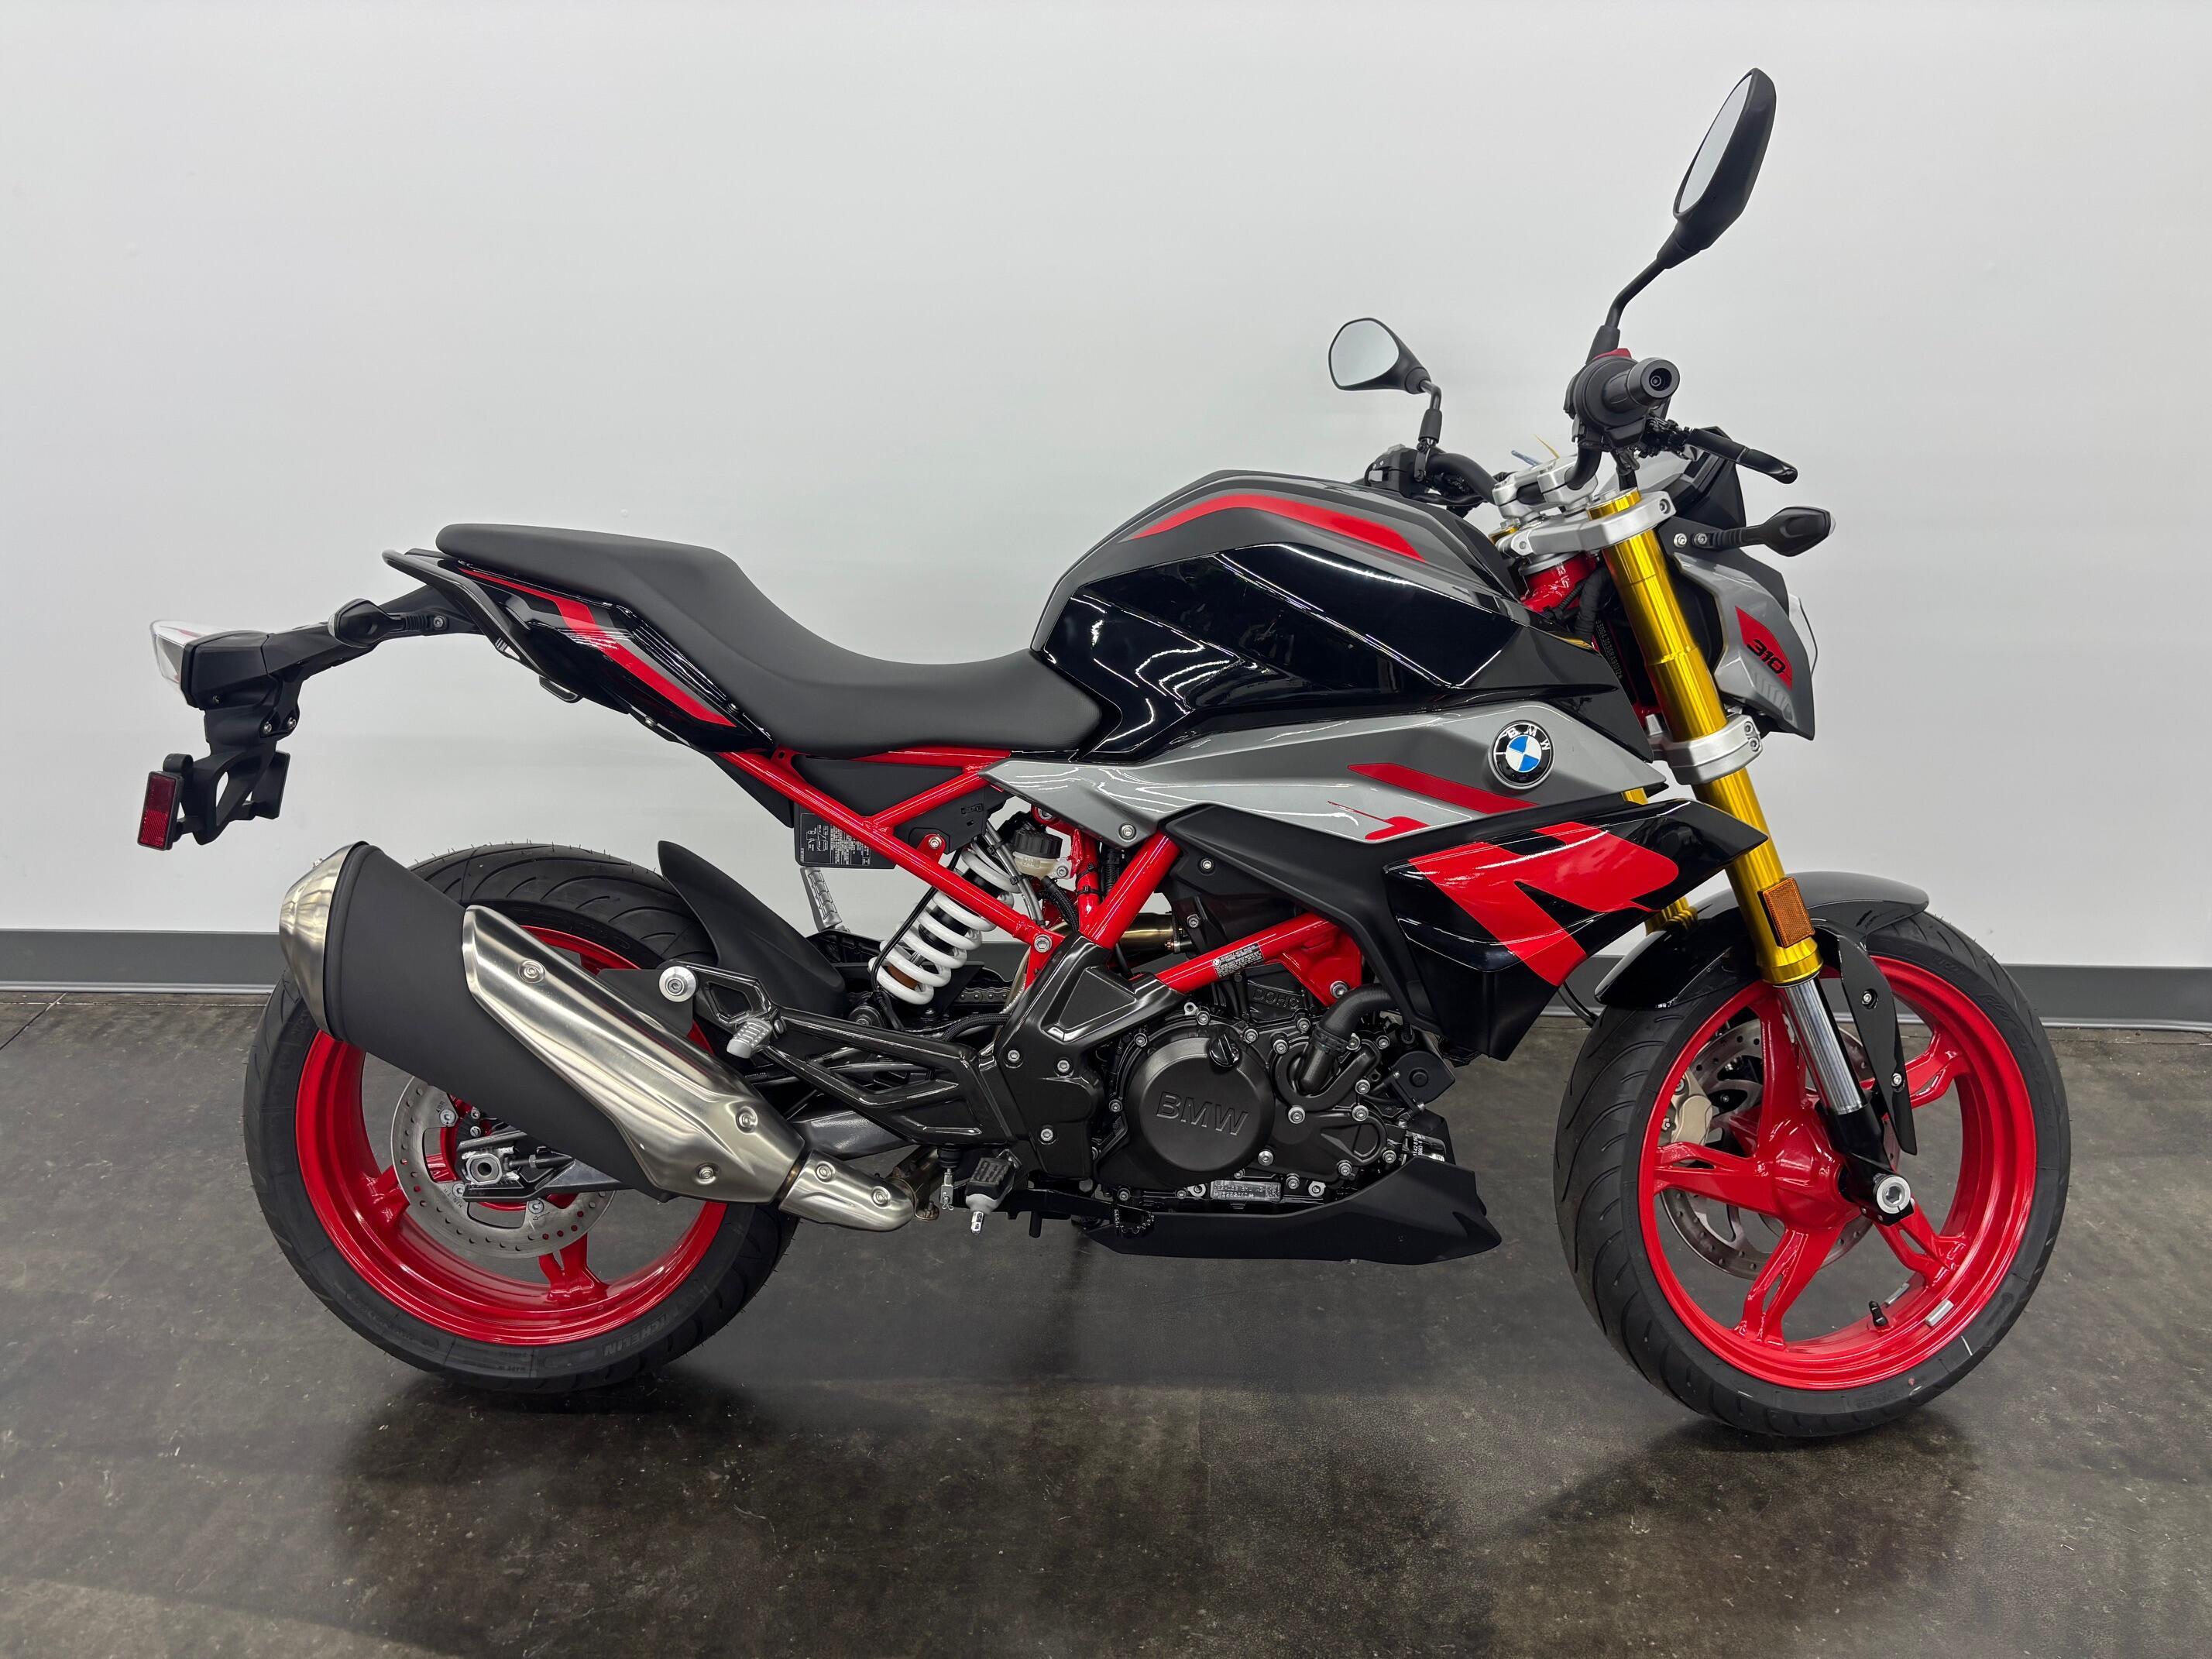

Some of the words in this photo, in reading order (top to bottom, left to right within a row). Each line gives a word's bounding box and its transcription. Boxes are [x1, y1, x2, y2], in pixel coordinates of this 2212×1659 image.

[1747, 639, 1786, 674] 310
[1506, 724, 1551, 750] BMW
[1253, 988, 1299, 1009] DOHC
[1156, 1091, 1249, 1136] BMW
